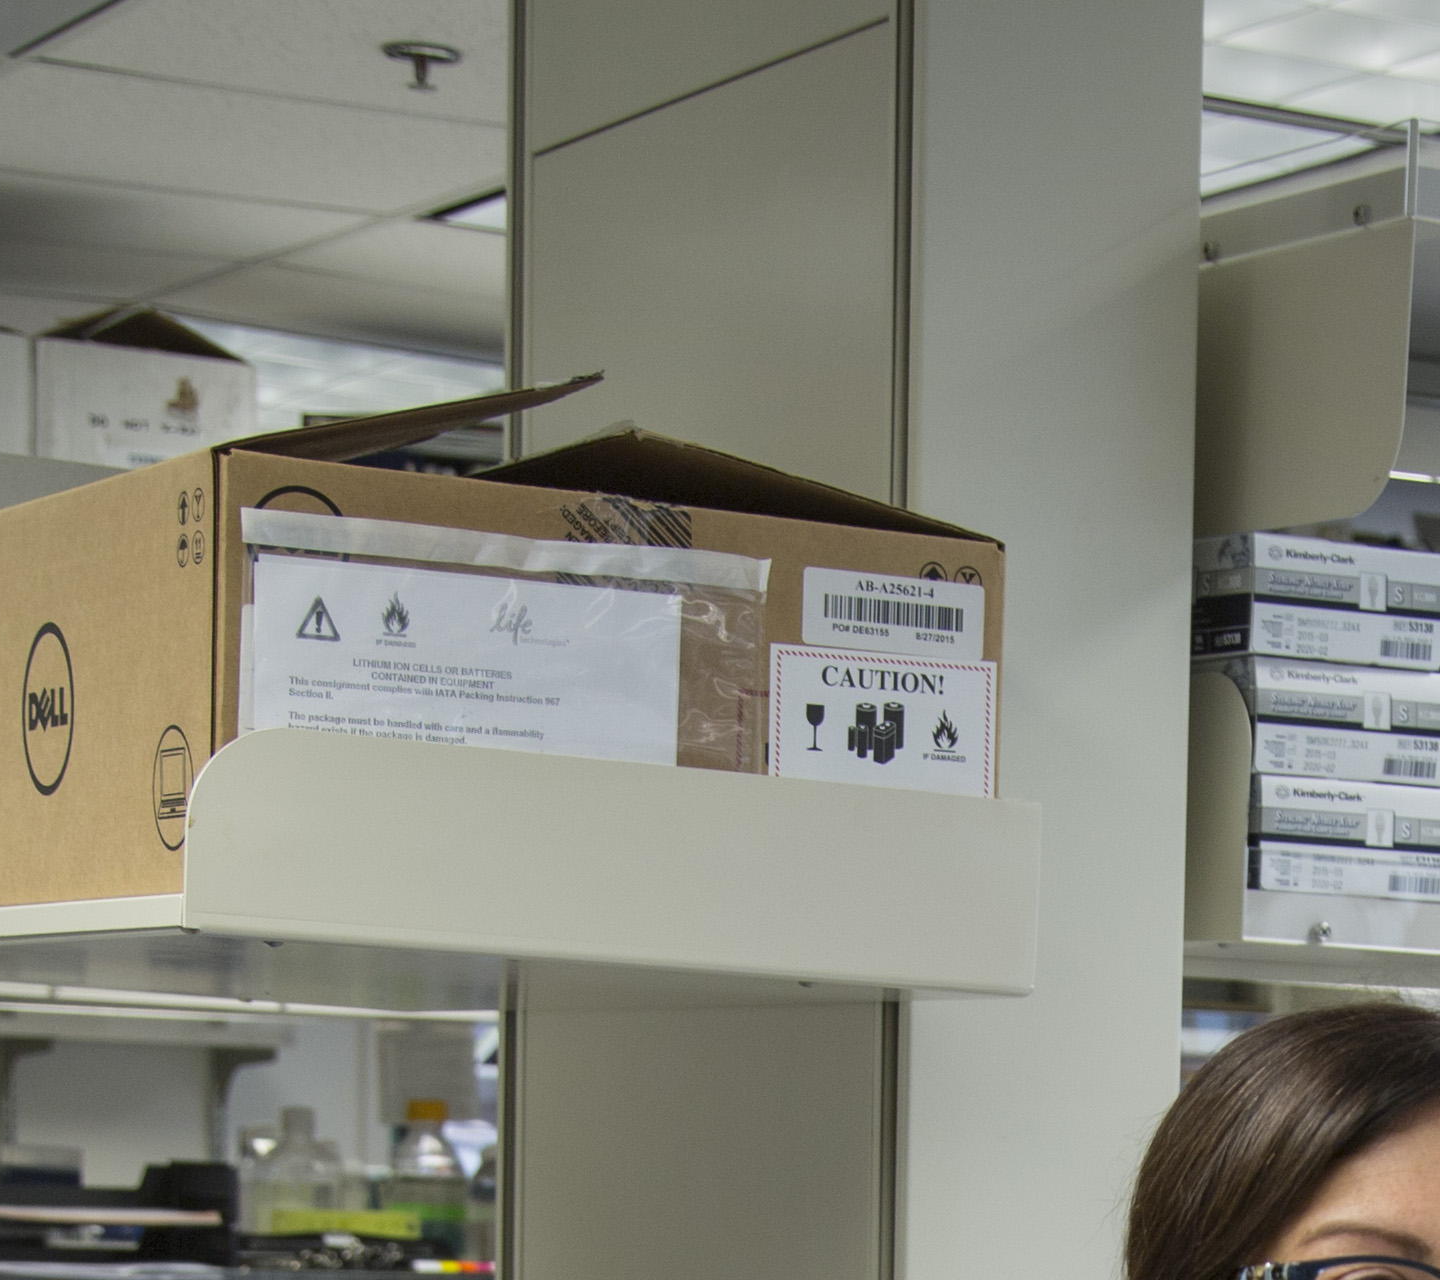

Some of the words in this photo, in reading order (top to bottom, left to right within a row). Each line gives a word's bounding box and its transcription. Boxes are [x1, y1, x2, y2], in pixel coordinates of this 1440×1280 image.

[1285, 549, 1355, 566] Kimberly-Clark
[855, 580, 934, 599] AB-A25621-4
[1394, 587, 1403, 604] S
[490, 603, 533, 646] life
[832, 623, 850, 633] PO#
[852, 625, 890, 637] DE63155
[1409, 621, 1434, 633] 53138
[915, 632, 955, 645] 8/27/2015
[353, 657, 391, 669] LITHIUM
[393, 661, 410, 671] ION
[412, 663, 442, 674] CELLS
[445, 665, 459, 675] OR
[461, 666, 512, 680] BATTERIES
[371, 671, 426, 685] CONTAINED
[428, 675, 438, 685] IN
[440, 677, 495, 689] EQUIPMENT
[821, 665, 945, 696] CAUTION!
[1287, 669, 1358, 686] Kimberly-Clark
[289, 676, 309, 687] This
[311, 678, 370, 691] consignment
[372, 683, 412, 696] complies
[414, 686, 434, 697] with
[435, 688, 457, 698] IATA
[459, 690, 494, 703] Packing
[496, 692, 543, 705] Instruction
[289, 688, 323, 700] Section
[28, 686, 68, 732] DELL
[1399, 706, 1409, 722] S
[289, 711, 306, 721] The
[308, 713, 347, 726] package
[348, 716, 371, 726] must
[373, 717, 385, 727] be
[387, 718, 422, 730] handled
[424, 721, 442, 732] with
[444, 725, 463, 733] care
[465, 724, 483, 735] and
[492, 726, 545, 740] flammability
[1413, 740, 1439, 751] 53138
[931, 753, 967, 763] DAMAGED
[1292, 790, 1363, 803] Kimberly-Clark
[1402, 823, 1411, 839] S
